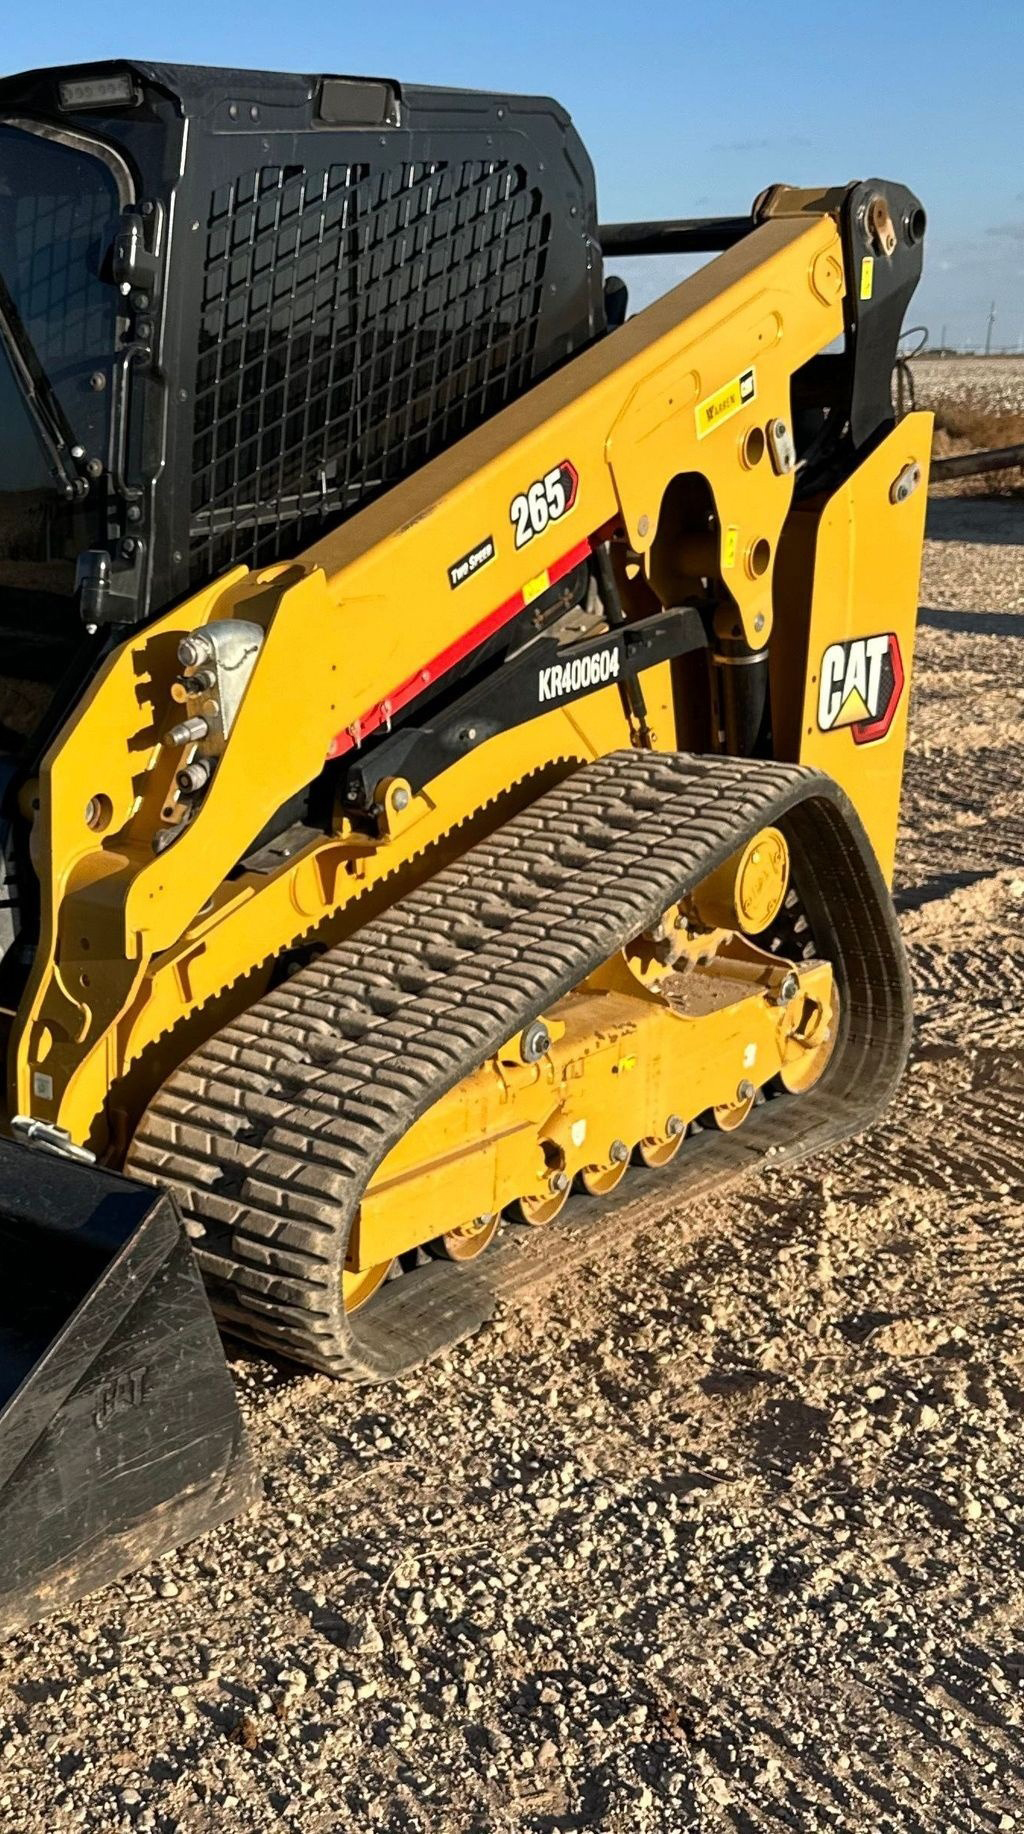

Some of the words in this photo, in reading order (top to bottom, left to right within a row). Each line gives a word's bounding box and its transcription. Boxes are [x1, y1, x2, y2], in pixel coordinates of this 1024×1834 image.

[510, 466, 566, 549] 265
[538, 646, 620, 702] KR400604
[817, 634, 889, 731] CAT
